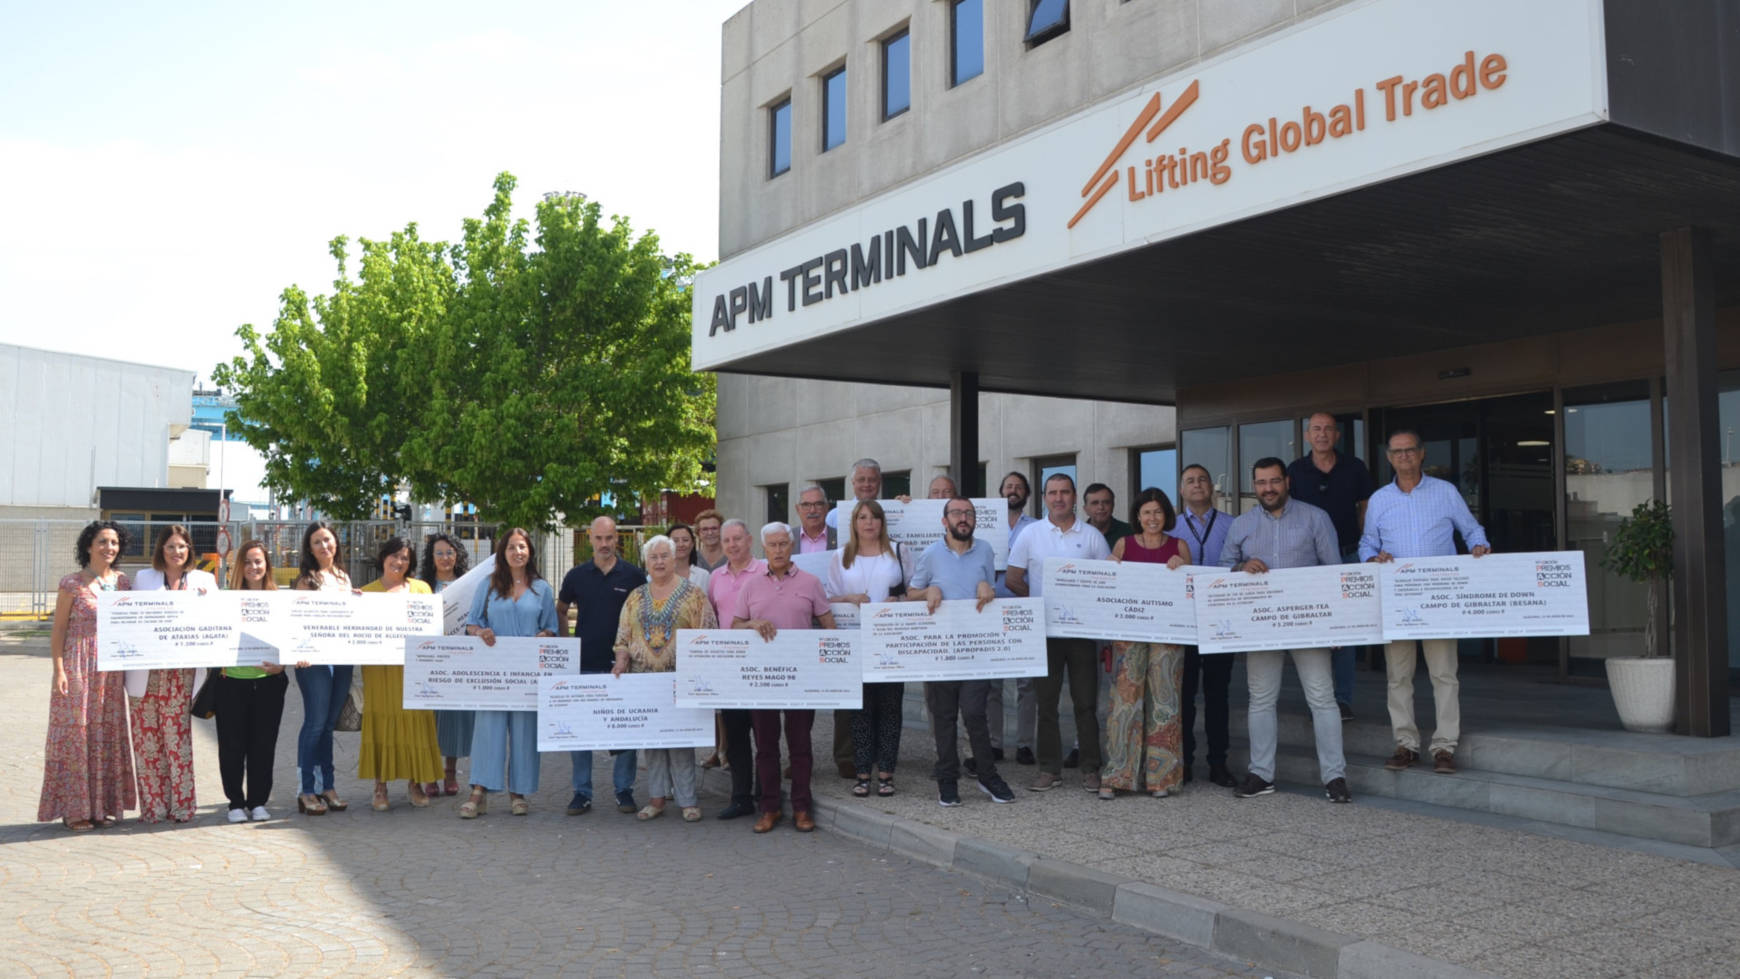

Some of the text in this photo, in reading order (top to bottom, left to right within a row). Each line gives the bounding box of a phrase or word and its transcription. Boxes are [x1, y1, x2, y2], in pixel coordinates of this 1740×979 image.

[1127, 50, 1508, 201] Lifting Global Trade
[709, 181, 1025, 337] APM TERMINALS
[1341, 575, 1374, 583] PREMIOS
[1536, 572, 1572, 580] ACCIÓN
[1341, 582, 1375, 591] ACCIÓN
[1456, 591, 1497, 600] SÍNDROME
[1096, 596, 1138, 605] ASOCIACIÓN
[1003, 616, 1034, 624] ACCIÓN
[1250, 614, 1277, 622] CAMPO
[957, 631, 1000, 639] PROMOCIÓN
[885, 640, 938, 649] PARTICIPACIÓN
[819, 648, 851, 656] ACCIÓN
